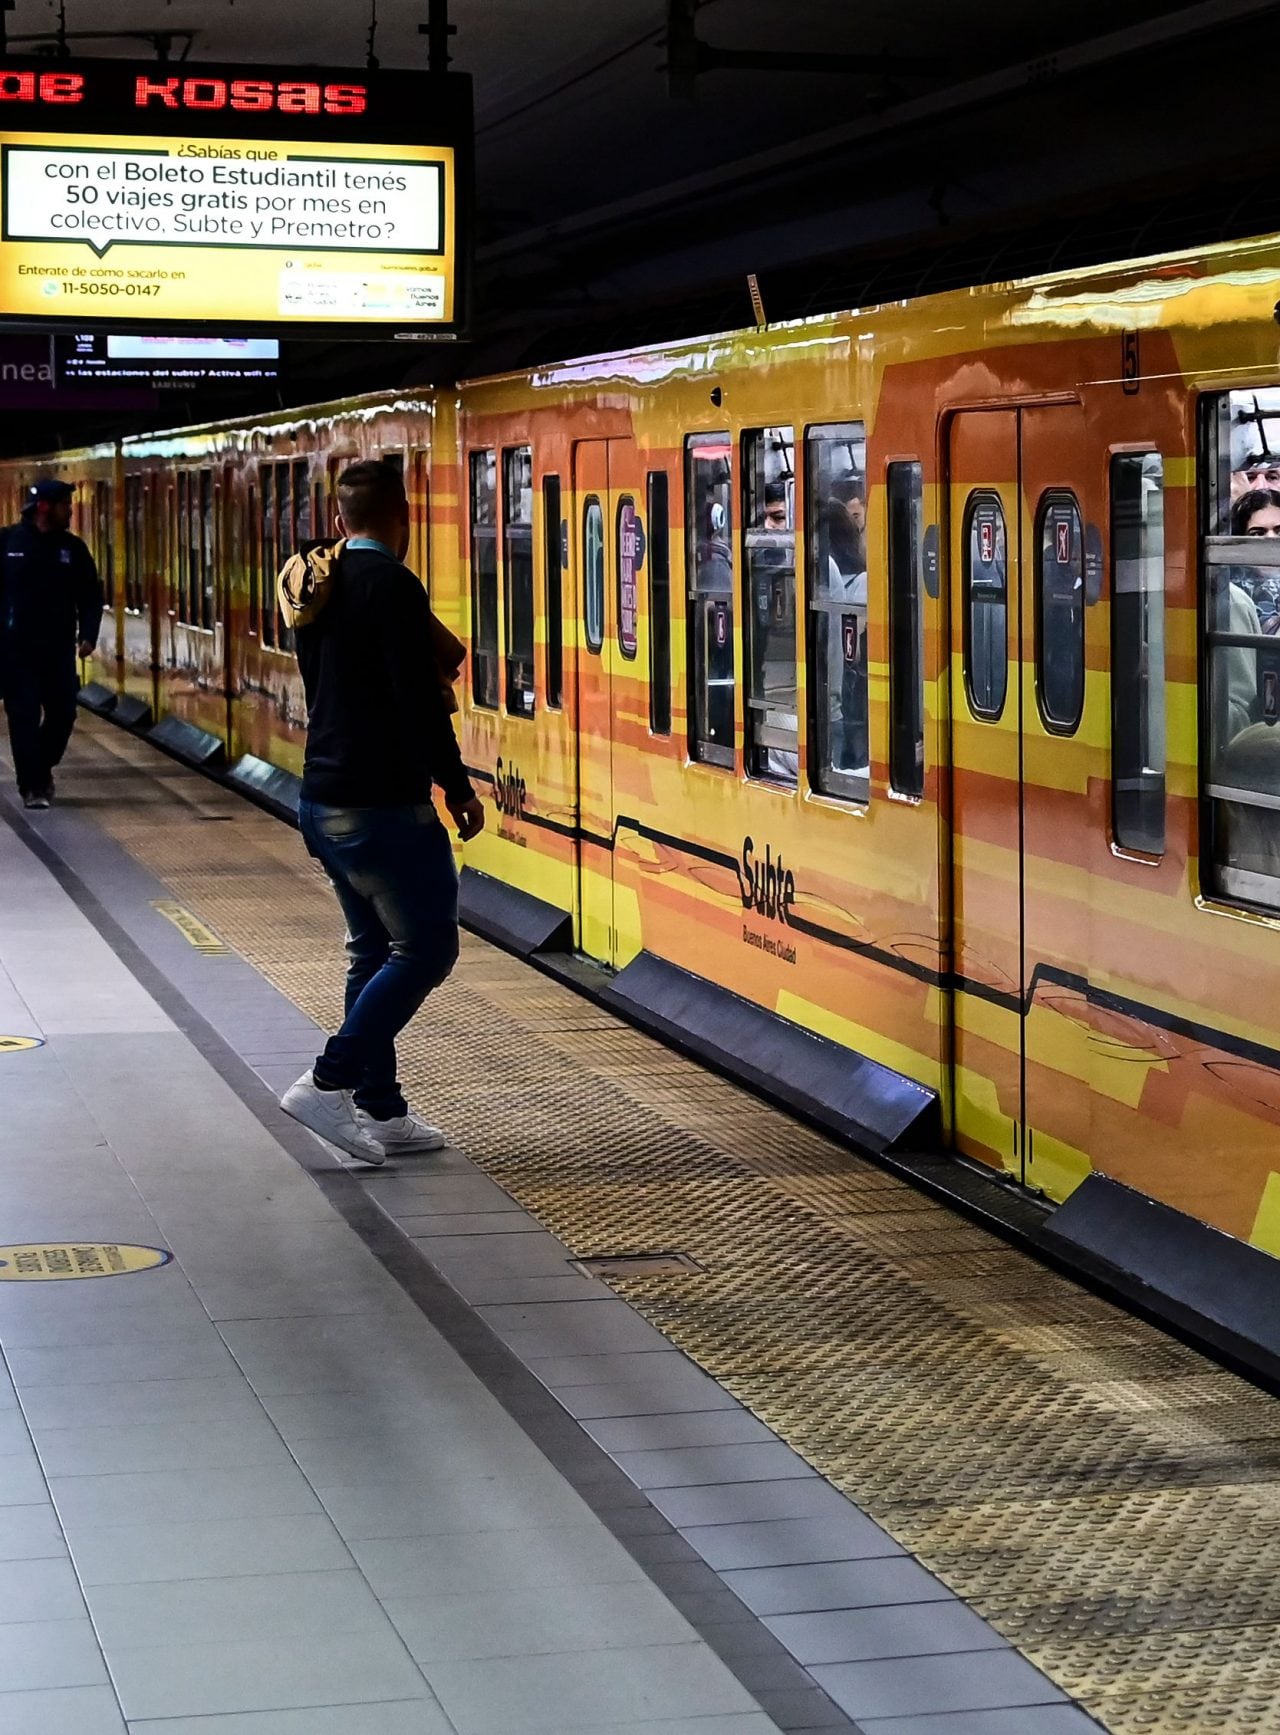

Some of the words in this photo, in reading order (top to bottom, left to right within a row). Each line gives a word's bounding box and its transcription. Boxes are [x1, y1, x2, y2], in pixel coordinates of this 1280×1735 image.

[177, 144, 241, 160] ¿Sabías
[246, 150, 278, 162] que
[44, 163, 89, 179] con
[97, 161, 116, 180] el
[125, 162, 204, 184] Boleto
[212, 166, 336, 188] Estudiantil
[344, 171, 407, 191] tenés
[66, 184, 99, 204] 50
[106, 186, 174, 210] viajes
[181, 190, 248, 211] gratis
[255, 196, 296, 213] por
[303, 197, 351, 213] mes
[358, 199, 387, 214] en
[50, 210, 166, 233] colectivo,
[173, 213, 243, 234] Subte
[250, 220, 263, 238] y
[271, 216, 396, 239] Premetro?
[18, 264, 69, 276] Enterate
[71, 266, 87, 277] de
[127, 269, 168, 279] sacarlo
[171, 271, 186, 280] en
[62, 282, 161, 297] 11-5050-0147
[741, 835, 795, 925] Subte
